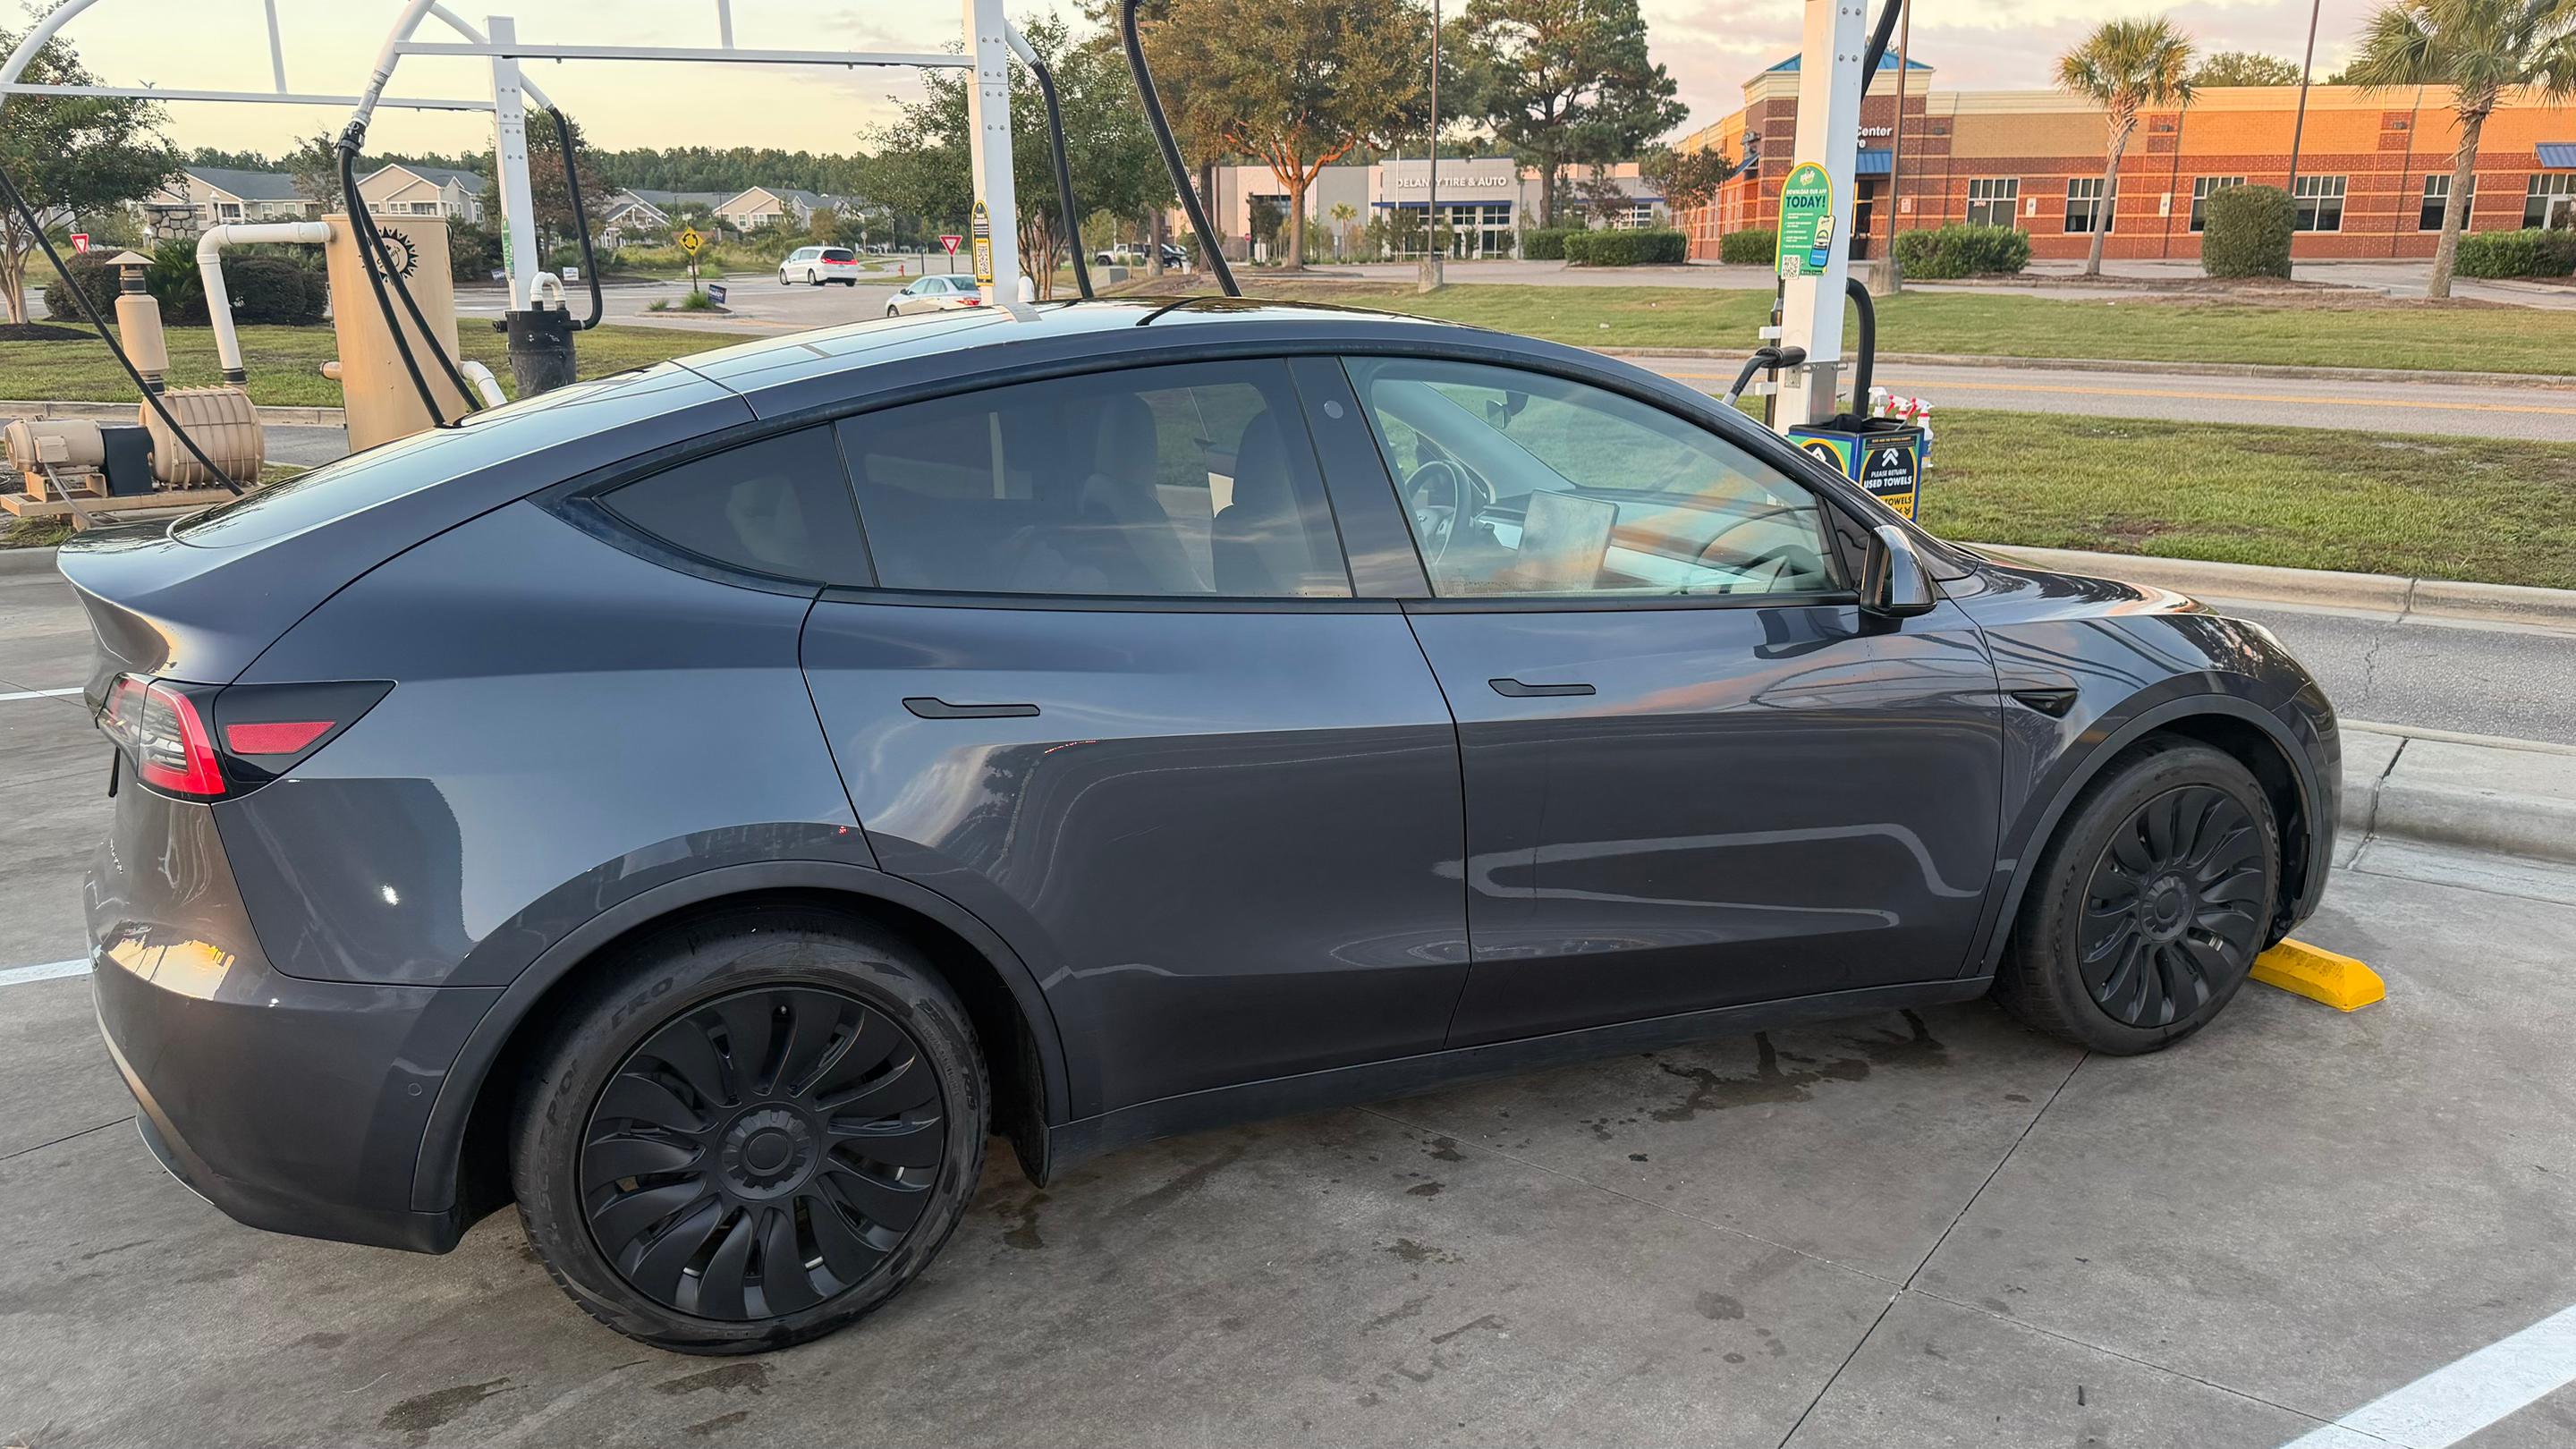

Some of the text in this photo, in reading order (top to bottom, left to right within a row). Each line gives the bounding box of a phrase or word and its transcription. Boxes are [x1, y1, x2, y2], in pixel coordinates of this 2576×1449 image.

[1396, 177, 1507, 188] DELANY TIRE & AUTO
[1786, 196, 1826, 208] TODAY!
[1870, 468, 1907, 478] PLEASE RETURN
[1863, 476, 1912, 488] USED TOWELS
[1884, 496, 1912, 506] TOWELS
